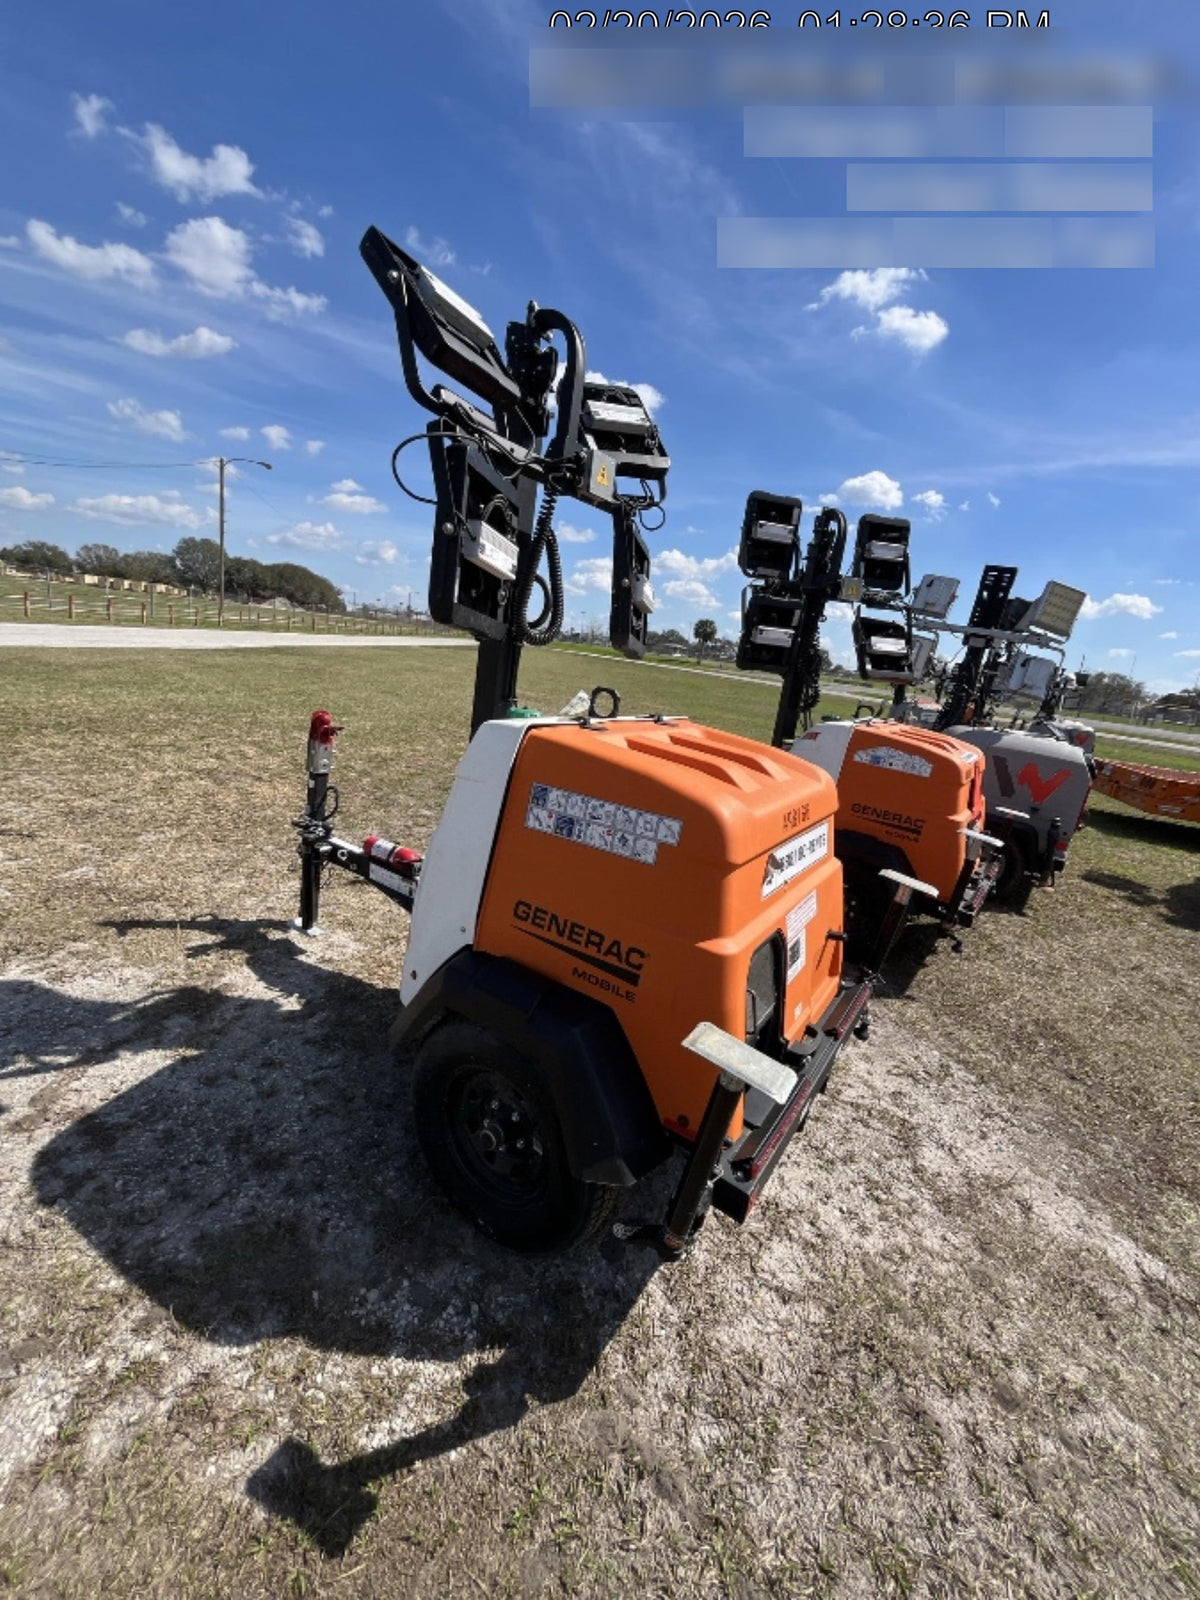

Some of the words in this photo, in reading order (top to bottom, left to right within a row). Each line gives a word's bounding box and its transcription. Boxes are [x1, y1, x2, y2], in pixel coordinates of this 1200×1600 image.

[851, 803, 925, 830] GENERAC
[513, 899, 646, 971] GENERAC
[571, 966, 637, 1002] MOBILE
